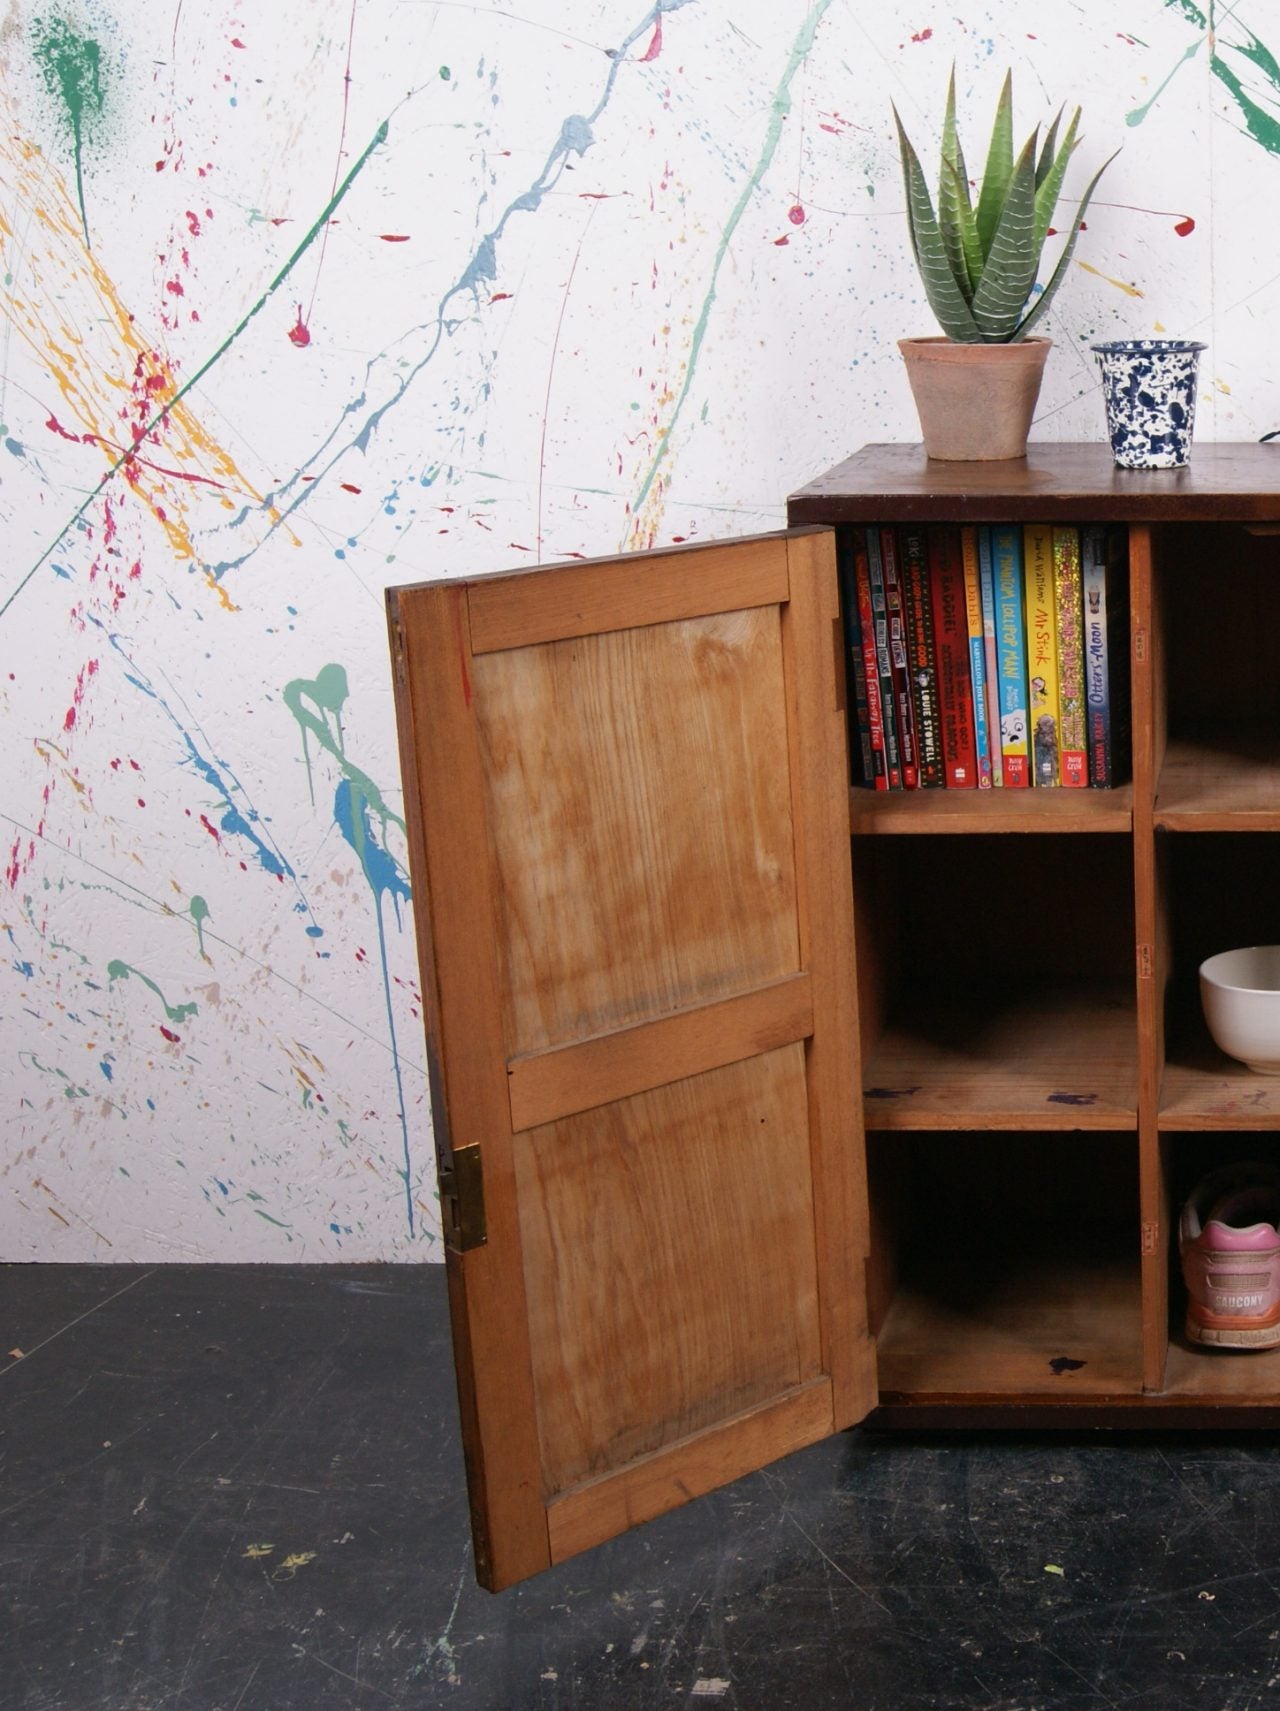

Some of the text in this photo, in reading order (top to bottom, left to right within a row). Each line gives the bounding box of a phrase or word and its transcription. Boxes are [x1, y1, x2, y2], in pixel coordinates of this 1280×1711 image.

[1000, 554, 1016, 600] PHANTOM
[918, 645, 928, 667] GOOD
[1036, 609, 1051, 666] Mr Stink
[1089, 622, 1104, 661] Moon
[880, 649, 890, 675] ROMANS
[974, 641, 986, 721] MARVELLOUS JOKE BOOK
[1003, 649, 1021, 679] MAN!
[867, 678, 880, 722] Faraway
[872, 725, 882, 745] Tree
[921, 690, 935, 762] LOUIE STOWELL
[1095, 742, 1105, 782] SUSANNA
[1215, 1294, 1264, 1308] SAUCONY
